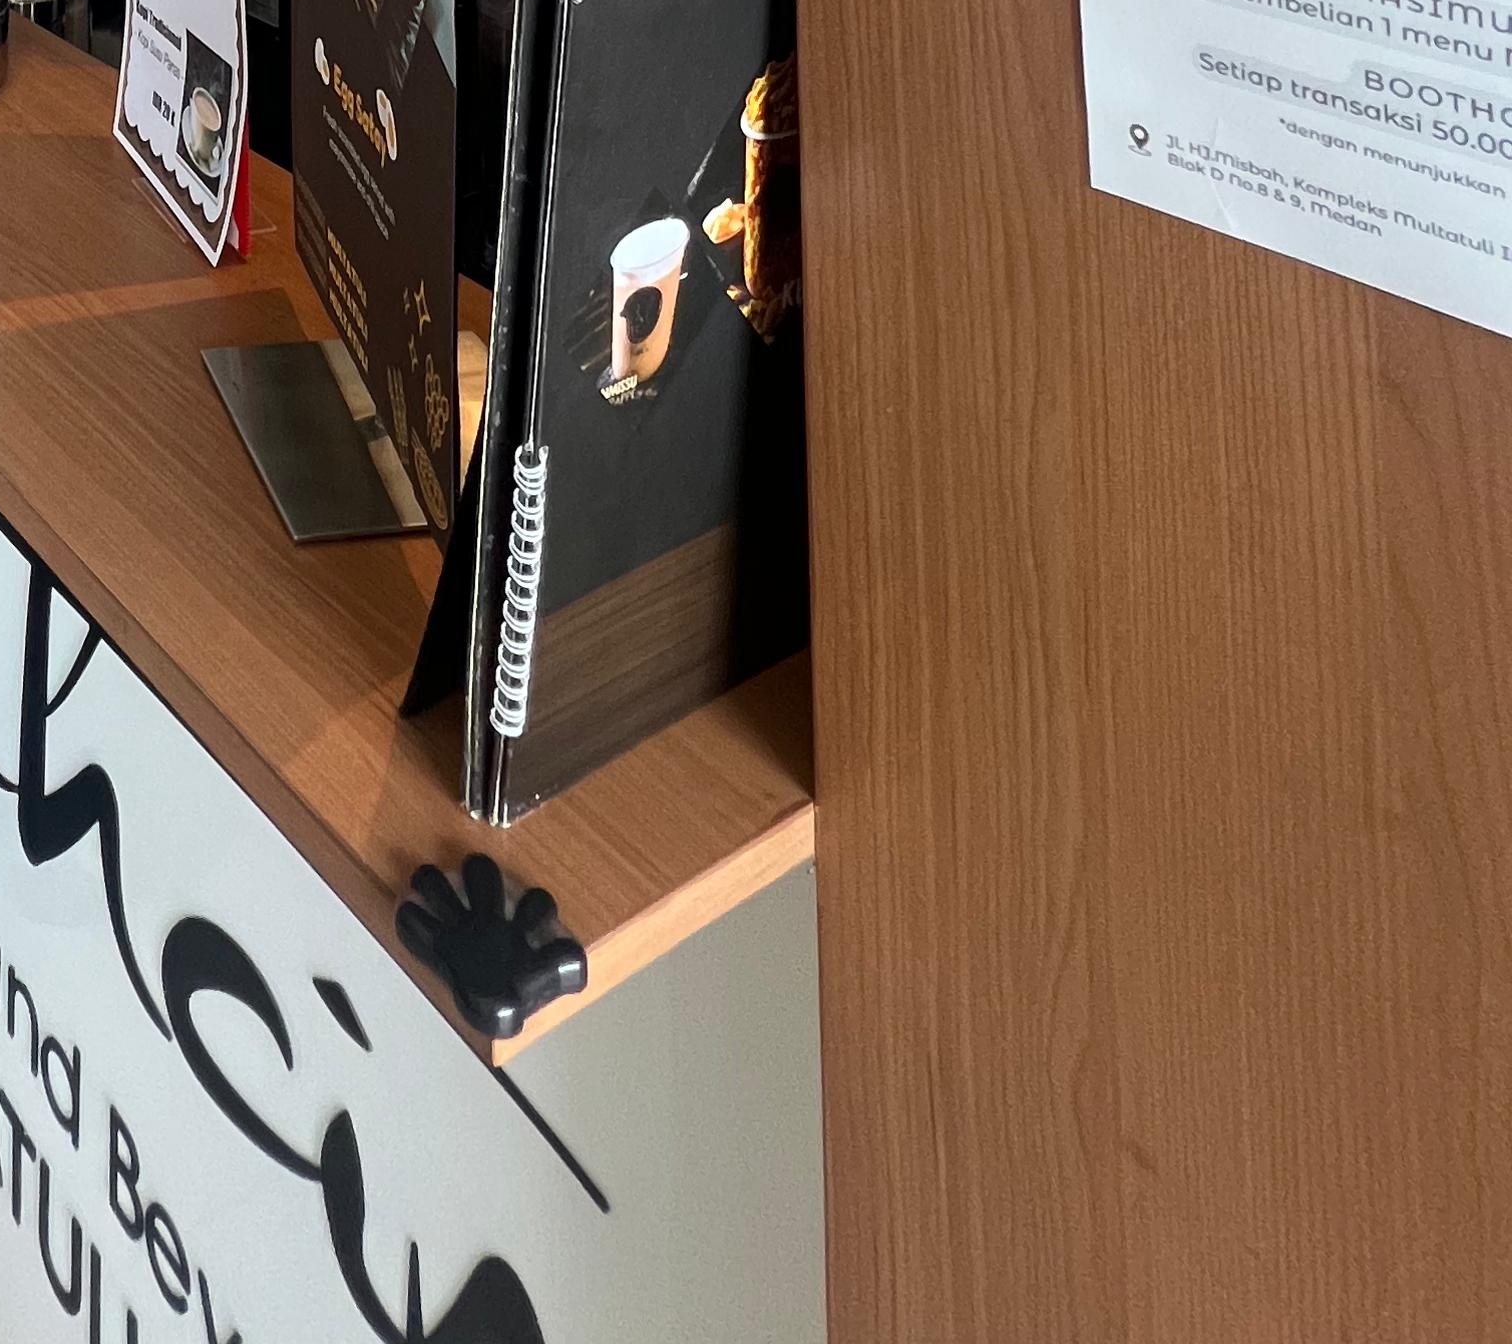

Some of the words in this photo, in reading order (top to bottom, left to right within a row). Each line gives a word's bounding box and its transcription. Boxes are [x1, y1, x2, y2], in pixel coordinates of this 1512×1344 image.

[1402, 26, 1493, 62] menu
[1199, 52, 1283, 93] Setiap
[1291, 79, 1422, 133] transaksi
[1167, 152, 1206, 176] Blok
[1210, 167, 1225, 181] D
[1273, 189, 1285, 203] &
[1310, 201, 1383, 238] Medan
[1293, 177, 1389, 220] Kompleks
[1363, 146, 1507, 199] menunjukkan
